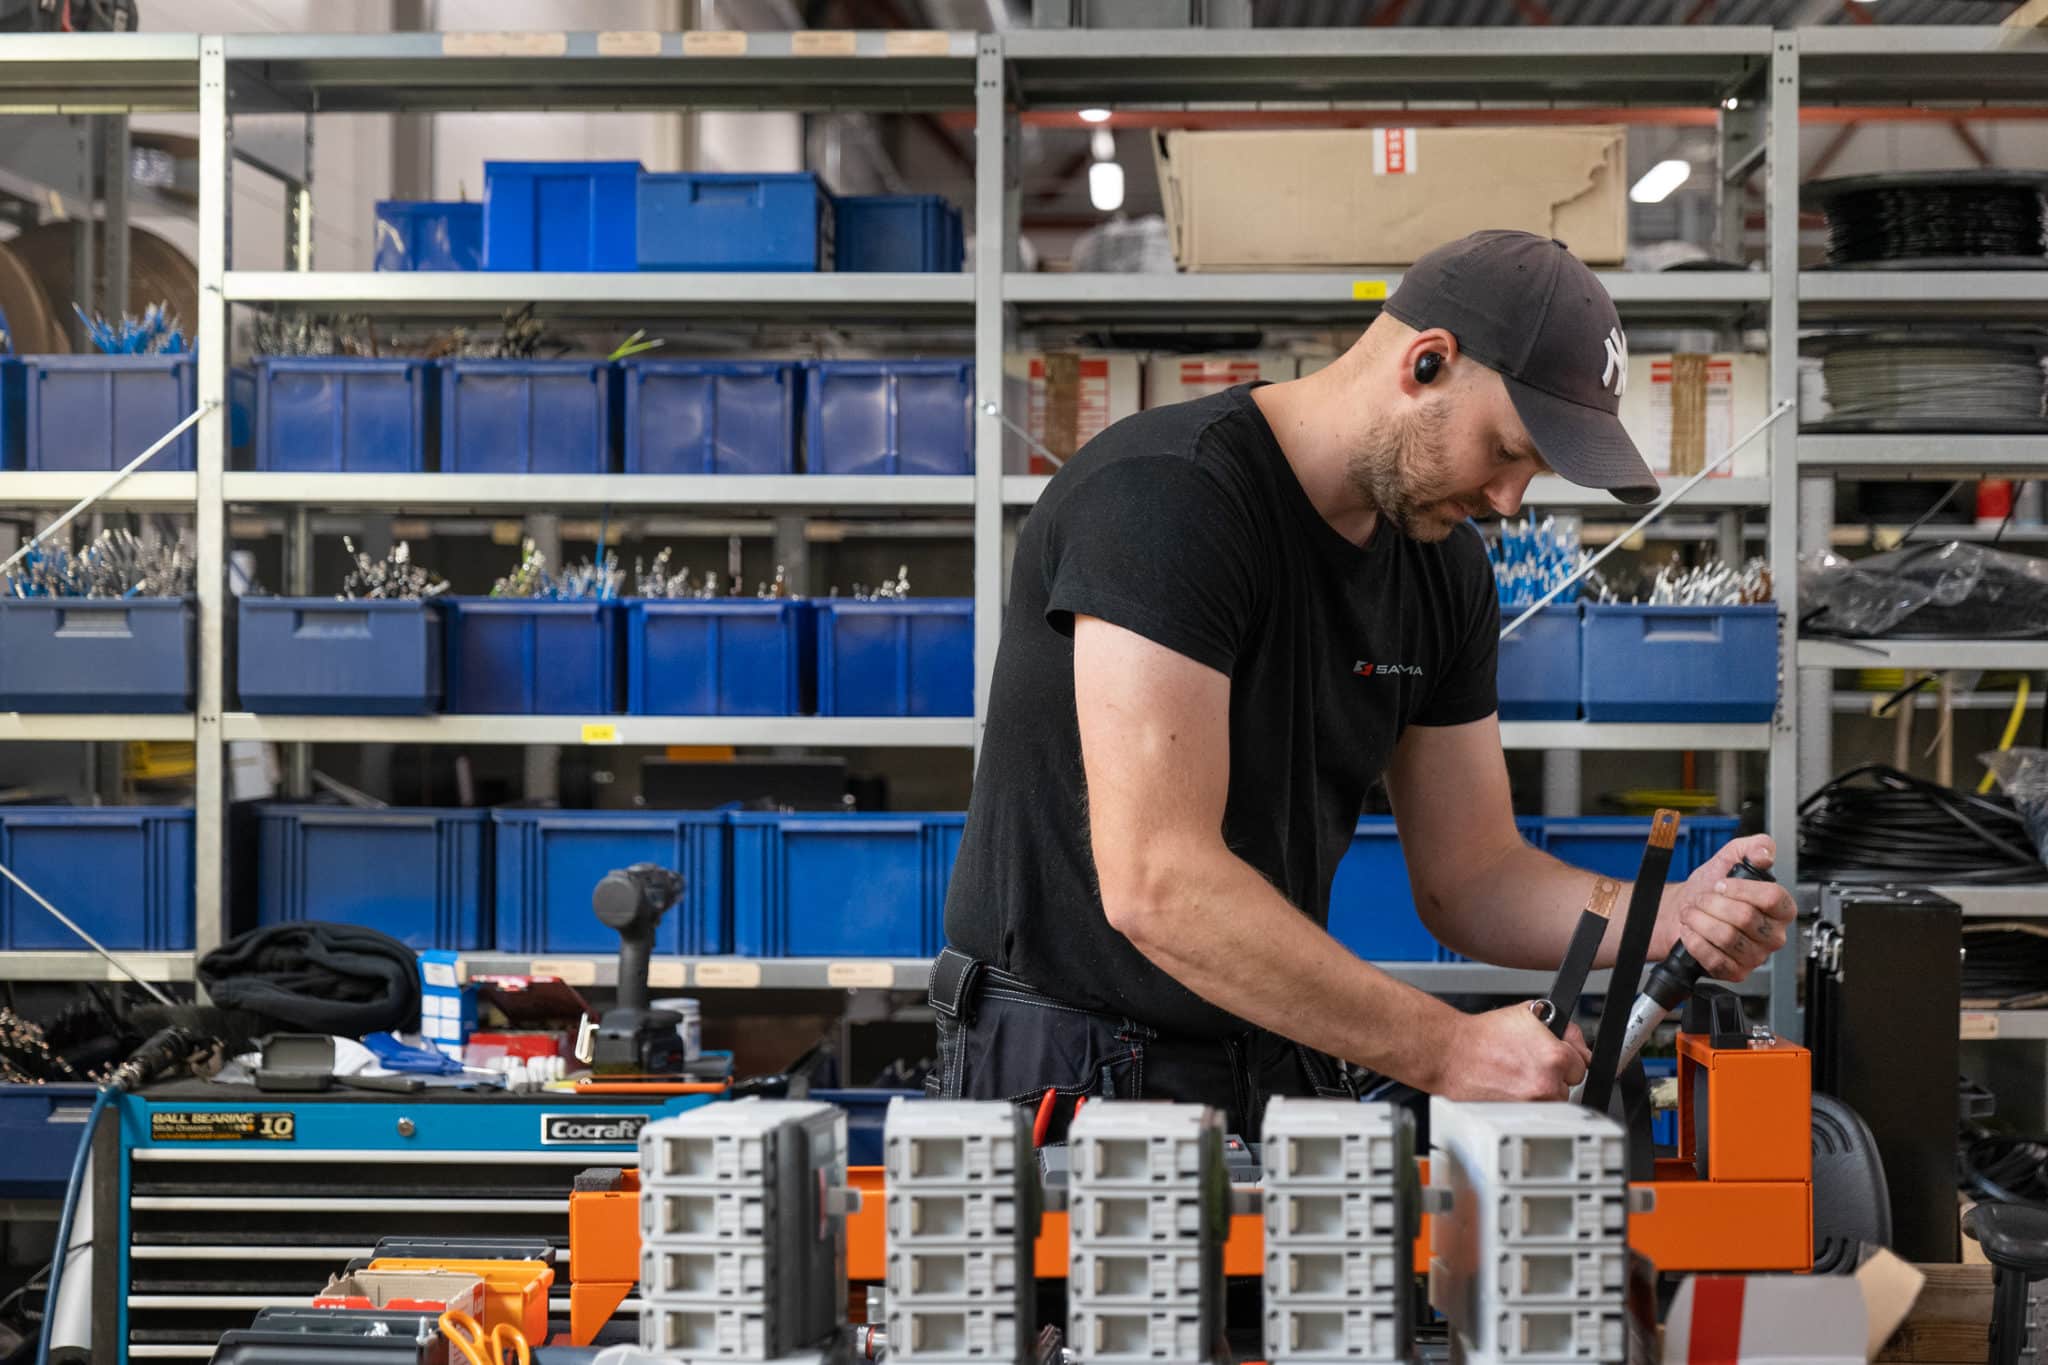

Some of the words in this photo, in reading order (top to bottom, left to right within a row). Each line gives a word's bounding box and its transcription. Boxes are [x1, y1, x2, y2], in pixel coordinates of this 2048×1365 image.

[152, 1113, 188, 1124] BALL
[191, 1112, 254, 1124] BEARING
[259, 1117, 293, 1135] 10
[551, 1120, 636, 1138] Cocraft
